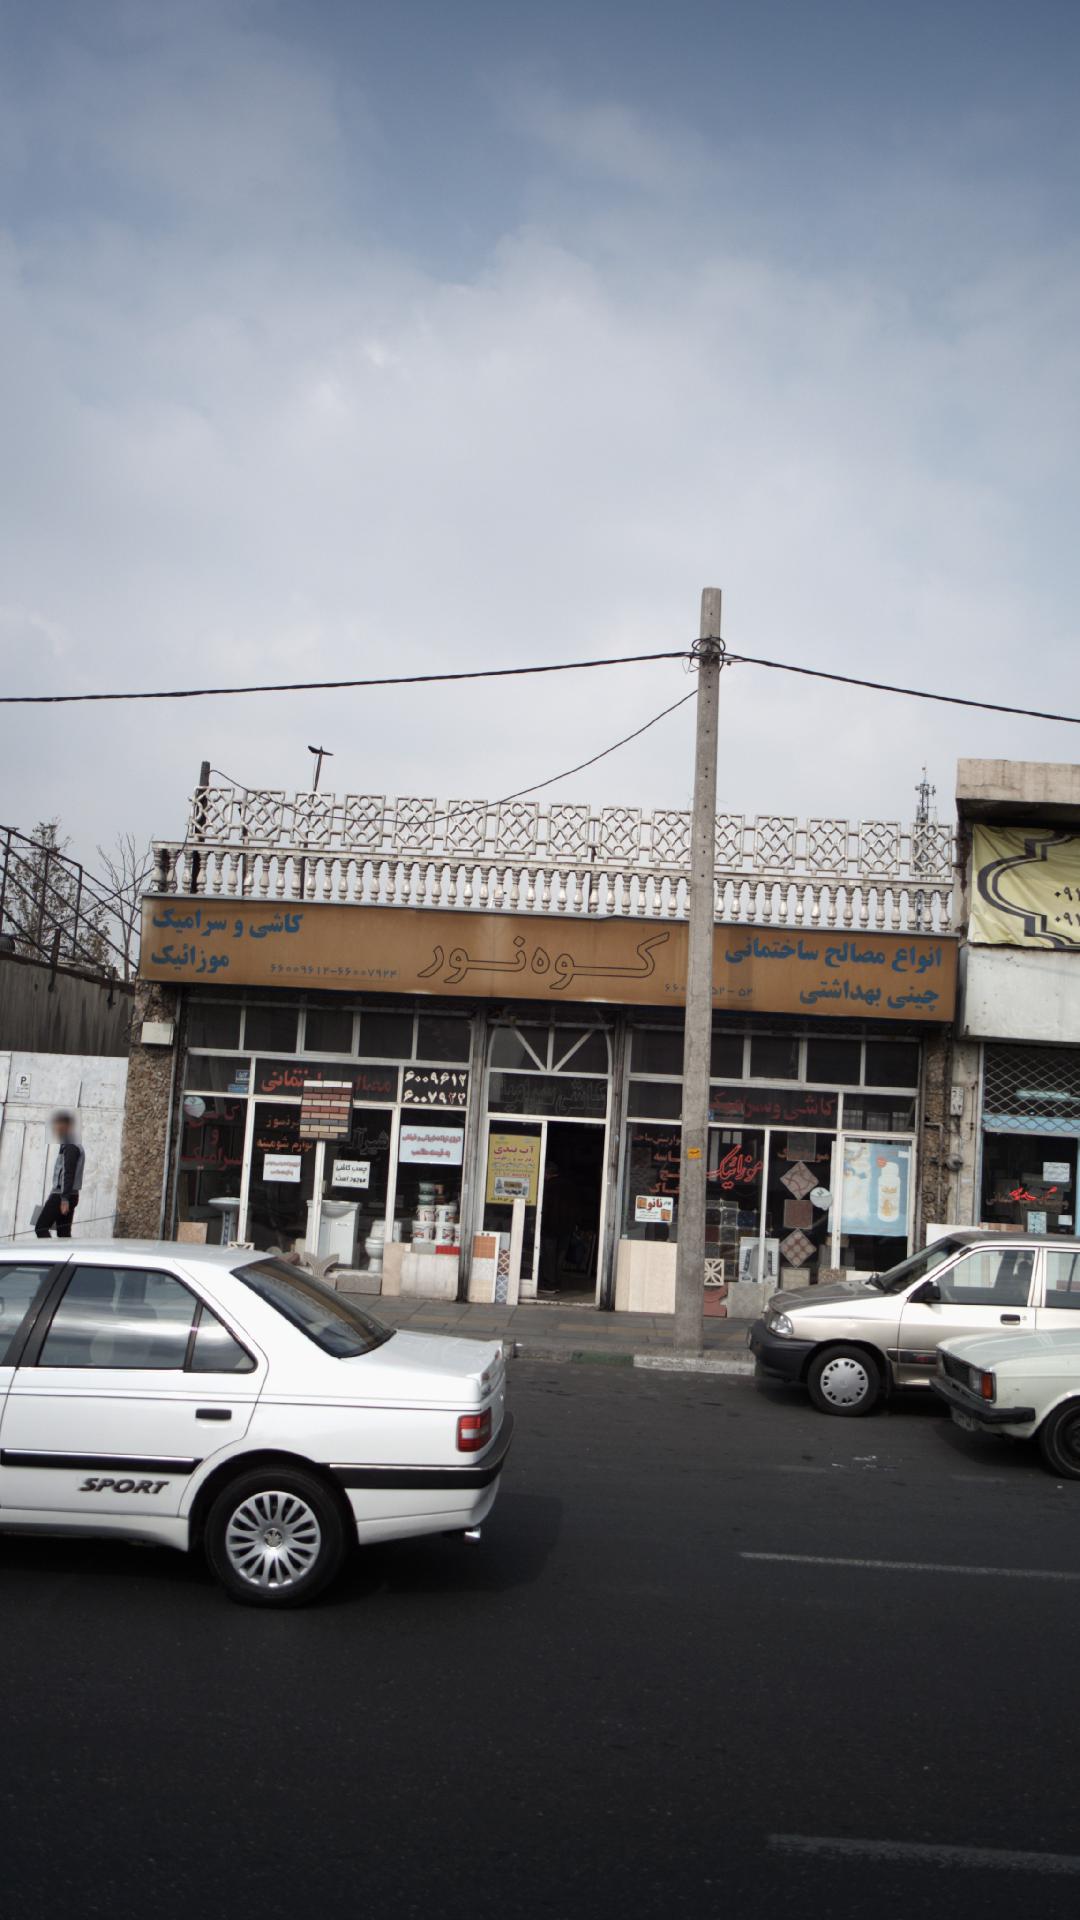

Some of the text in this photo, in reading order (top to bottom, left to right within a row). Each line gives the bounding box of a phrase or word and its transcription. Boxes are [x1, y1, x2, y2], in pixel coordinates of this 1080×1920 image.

[152, 909, 304, 938] کاشی و سرامیک
[725, 937, 942, 974] انواع مصالح ساختمانی
[799, 978, 939, 1011] چینی بهداشتی
[79, 1477, 170, 1494] SPORT
